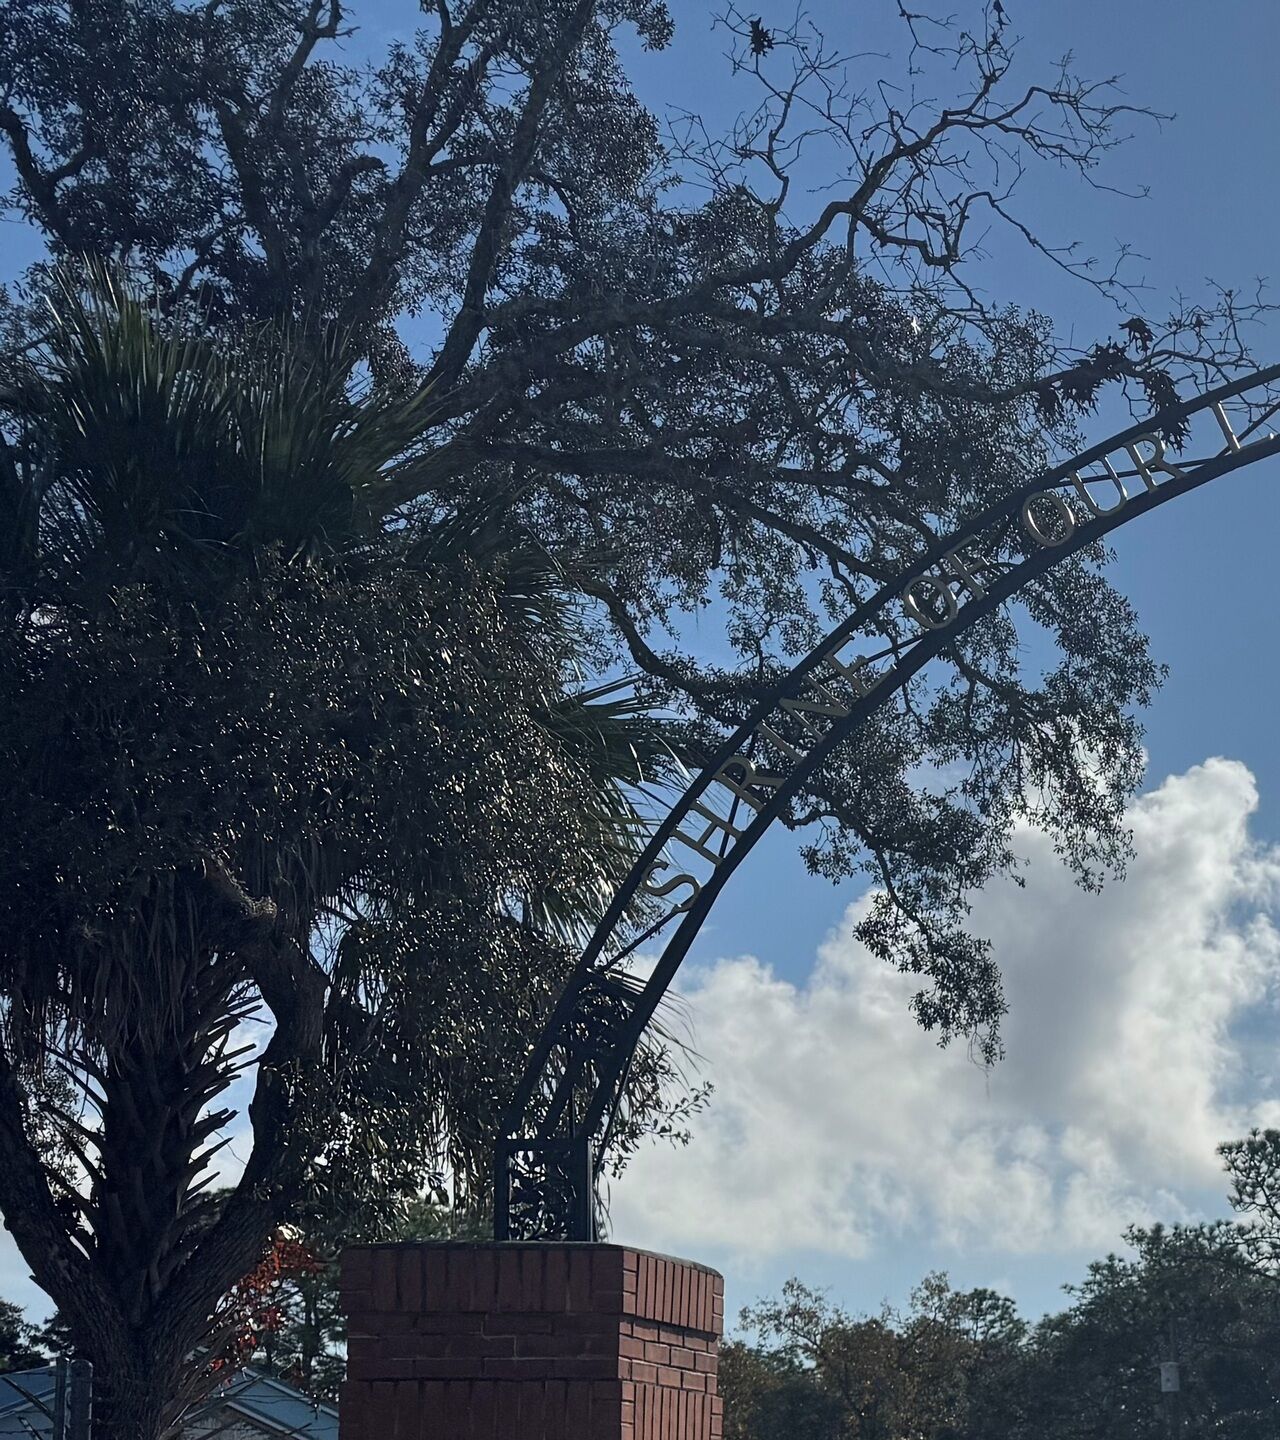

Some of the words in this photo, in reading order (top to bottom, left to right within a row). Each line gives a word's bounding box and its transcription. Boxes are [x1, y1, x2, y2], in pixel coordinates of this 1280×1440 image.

[641, 634, 898, 913] SHRINE
[903, 534, 990, 630] OF
[1022, 432, 1188, 548] OUR
